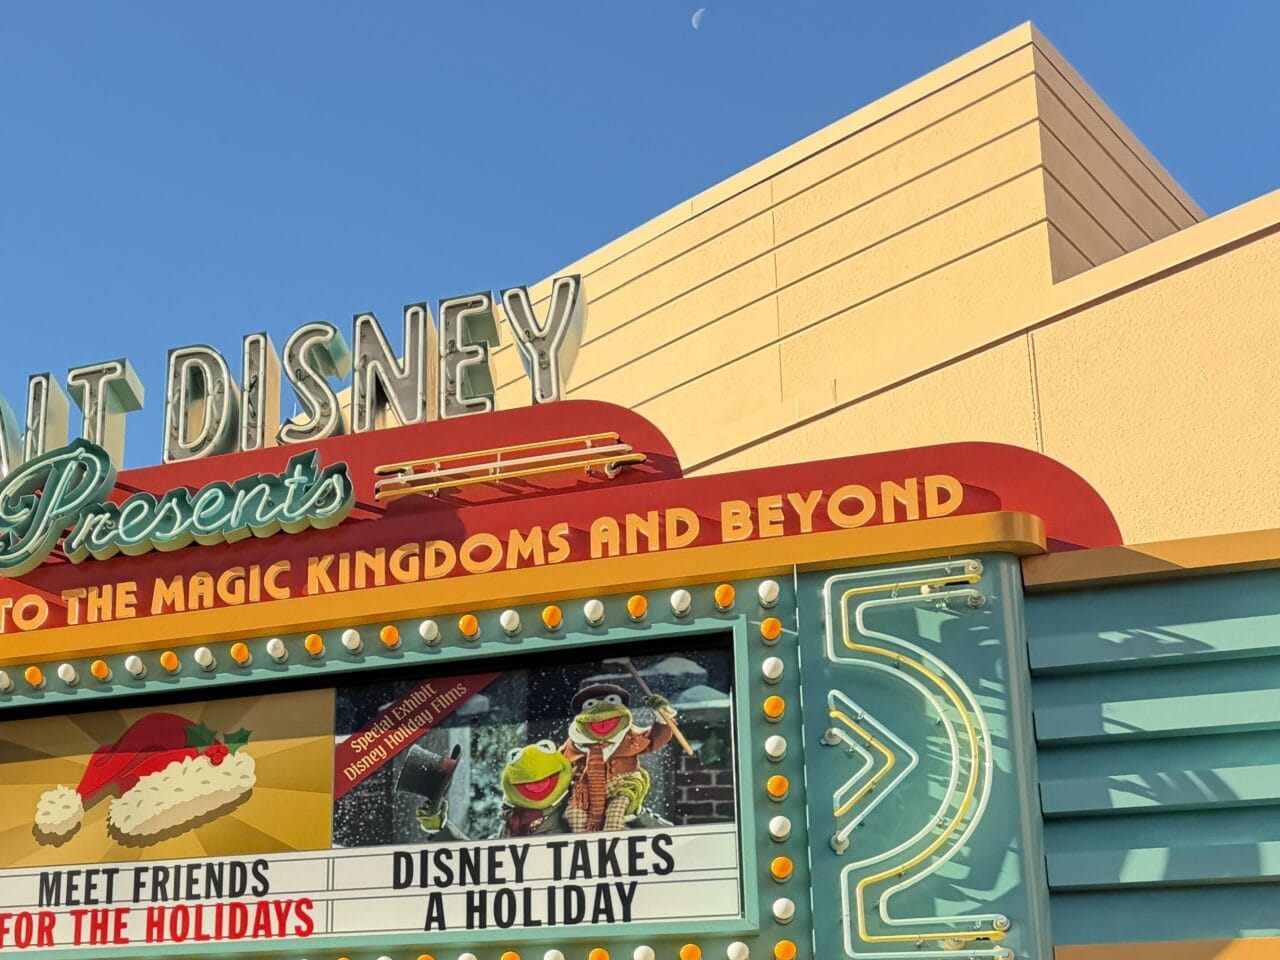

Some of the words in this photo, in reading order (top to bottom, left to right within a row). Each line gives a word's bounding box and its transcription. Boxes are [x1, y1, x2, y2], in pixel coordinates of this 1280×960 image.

[162, 274, 584, 464] DISNEY
[61, 581, 137, 626] THE
[150, 560, 291, 613] MAGIC
[306, 524, 570, 597] KINGDOMS
[590, 507, 701, 559] AND
[720, 474, 965, 543] BEYOND
[343, 745, 388, 781] Disney
[384, 709, 434, 749] Holiday
[431, 683, 467, 713] Films
[351, 715, 395, 753] Special
[392, 683, 437, 720] Exhibit
[38, 868, 119, 907] MEET
[132, 859, 270, 902] FRIENDS
[393, 843, 530, 890] DISNEY
[547, 833, 675, 881] TAKES
[70, 907, 130, 946] THE
[146, 897, 314, 943] HOLIDAYS
[424, 892, 447, 932] A
[466, 881, 638, 929] HOLIDAY
